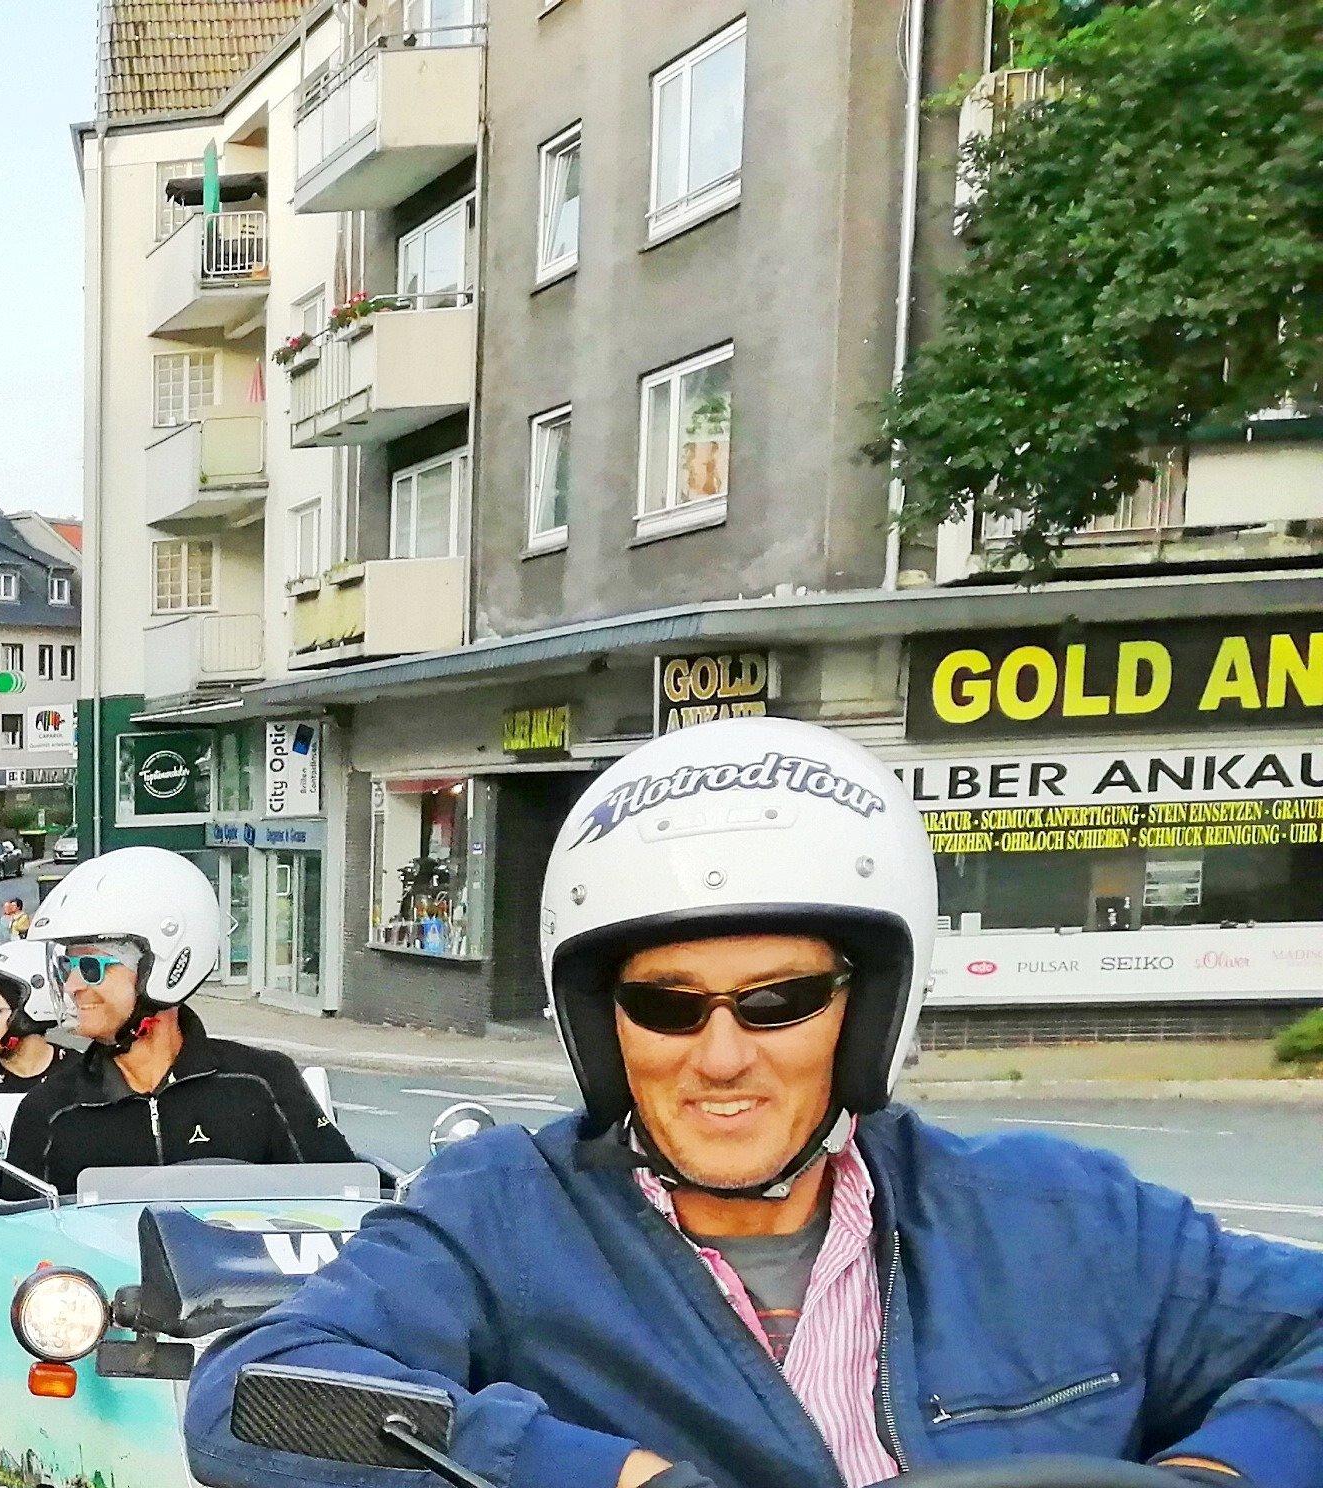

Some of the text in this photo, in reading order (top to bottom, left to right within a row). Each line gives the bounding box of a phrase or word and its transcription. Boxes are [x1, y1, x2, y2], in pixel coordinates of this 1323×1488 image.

[663, 652, 768, 703] GOLD
[931, 640, 1173, 724] GOLD
[269, 723, 289, 773] Optic
[269, 780, 288, 813] City
[980, 807, 1045, 830] SCHMUCK
[1045, 804, 1139, 828] ANFERTIGUNG
[1148, 803, 1187, 824] STEIN
[1188, 801, 1264, 823] EINSETZEN
[1001, 830, 1066, 852] OHRLOCH
[1139, 826, 1204, 848] SCHMUCK
[1205, 824, 1280, 846] REINIGUNG
[1290, 823, 1318, 845] UHR
[1017, 960, 1081, 974] PULSAR
[1100, 955, 1175, 972] SEIKO
